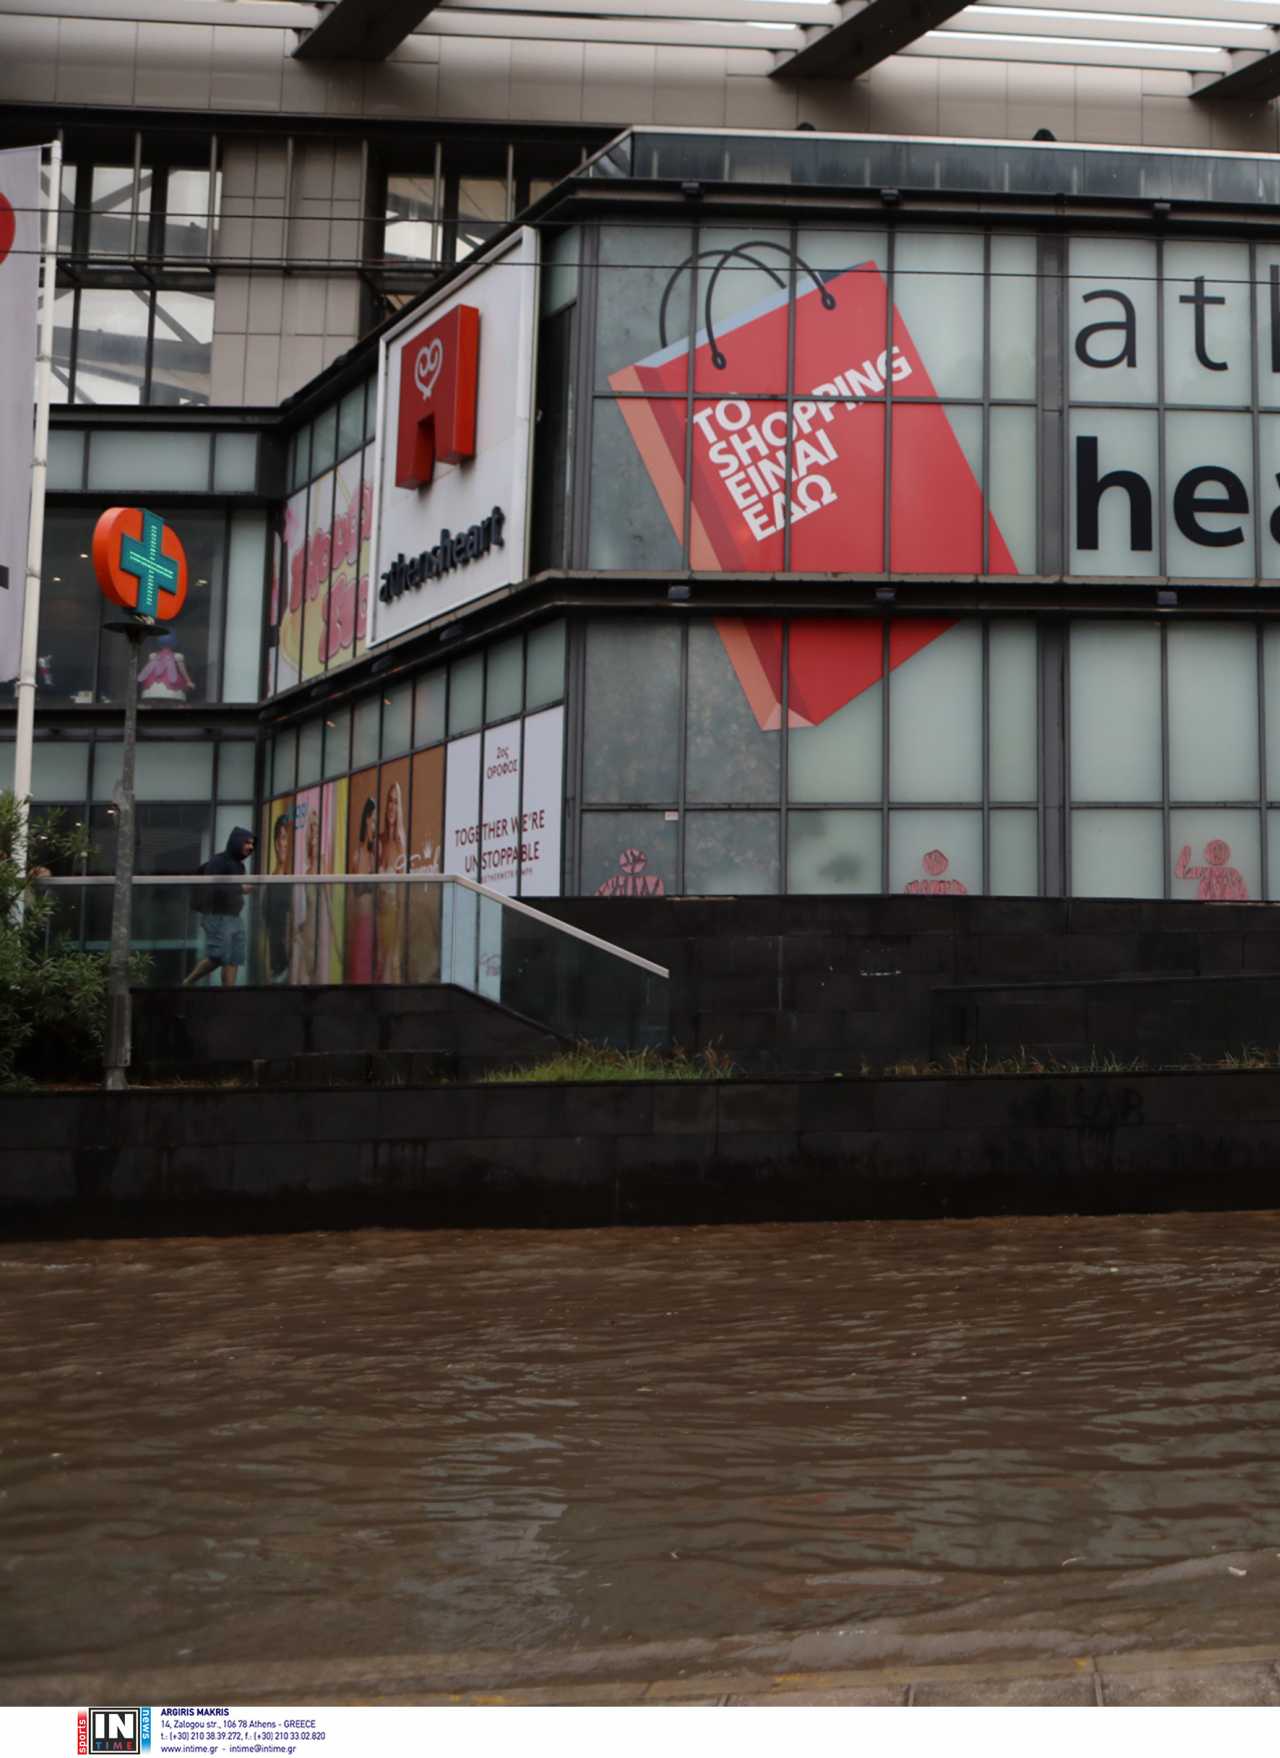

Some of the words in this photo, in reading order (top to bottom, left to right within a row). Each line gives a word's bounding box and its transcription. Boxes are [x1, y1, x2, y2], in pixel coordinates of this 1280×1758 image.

[708, 345, 913, 479] SHOPPING
[723, 429, 839, 510] ΕΙΝΑΙ
[742, 474, 838, 542] ΕΔΩ
[379, 506, 505, 605] athensheart
[454, 817, 509, 848] TOGETHER
[511, 809, 546, 835] WE'RE
[464, 840, 541, 874] UNSTOPPABLE
